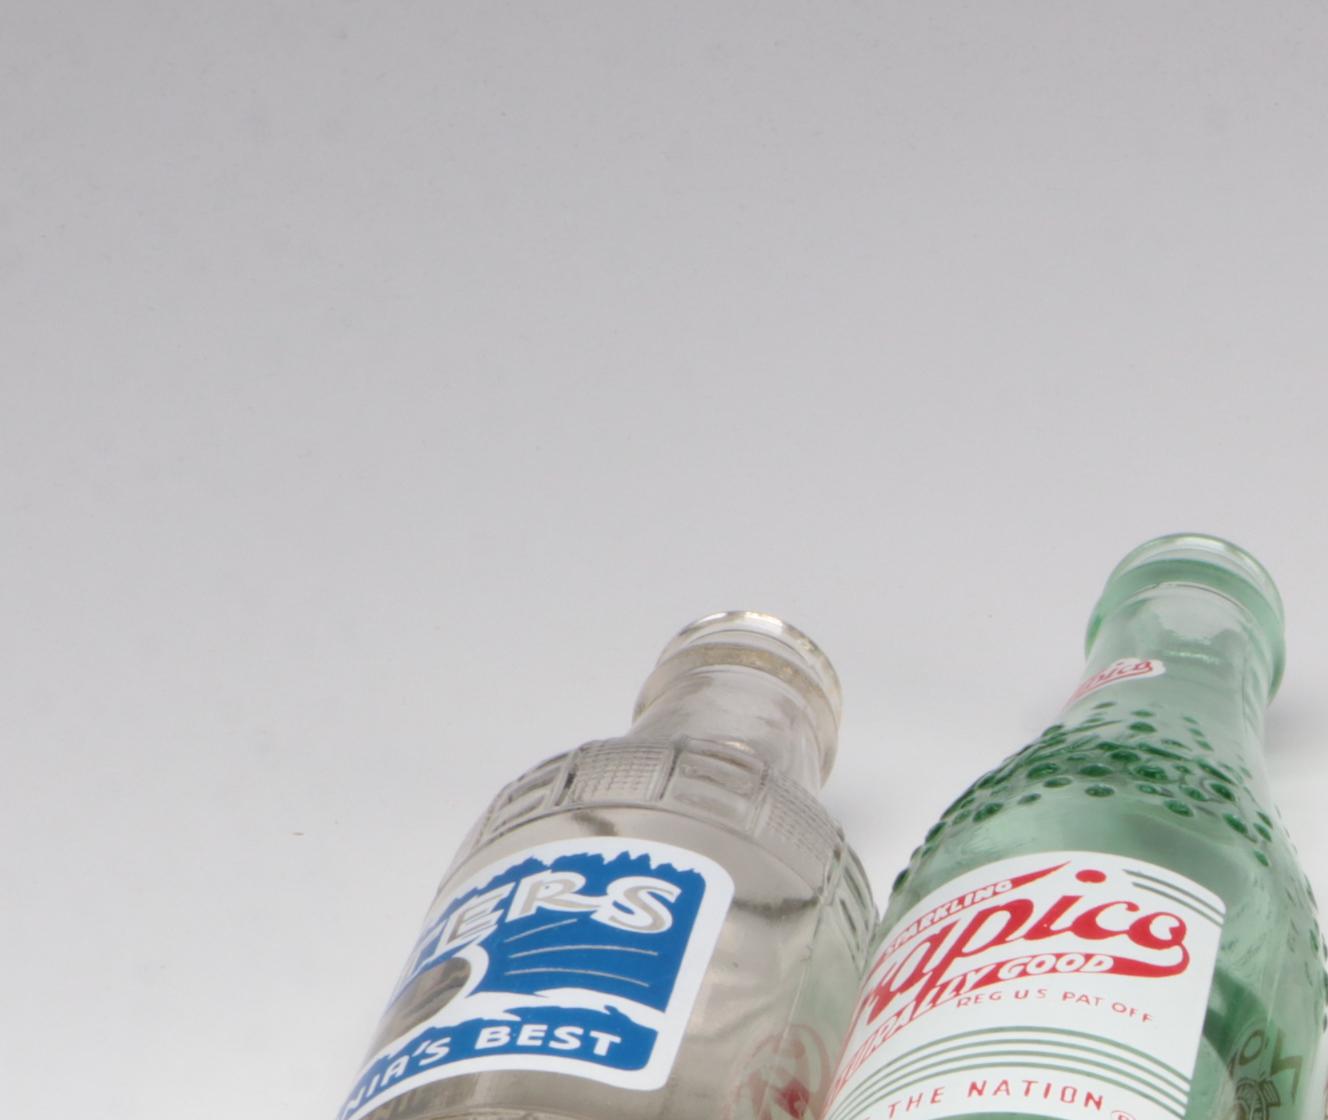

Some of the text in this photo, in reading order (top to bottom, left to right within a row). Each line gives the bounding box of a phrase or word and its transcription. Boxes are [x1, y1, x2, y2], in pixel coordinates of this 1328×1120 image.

[998, 953, 1114, 981] GOOD
[956, 988, 1153, 1025] REG U S PAT OFF
[474, 1022, 622, 1057] BEST
[888, 1086, 945, 1120] THE
[967, 1079, 1104, 1112] NATION
